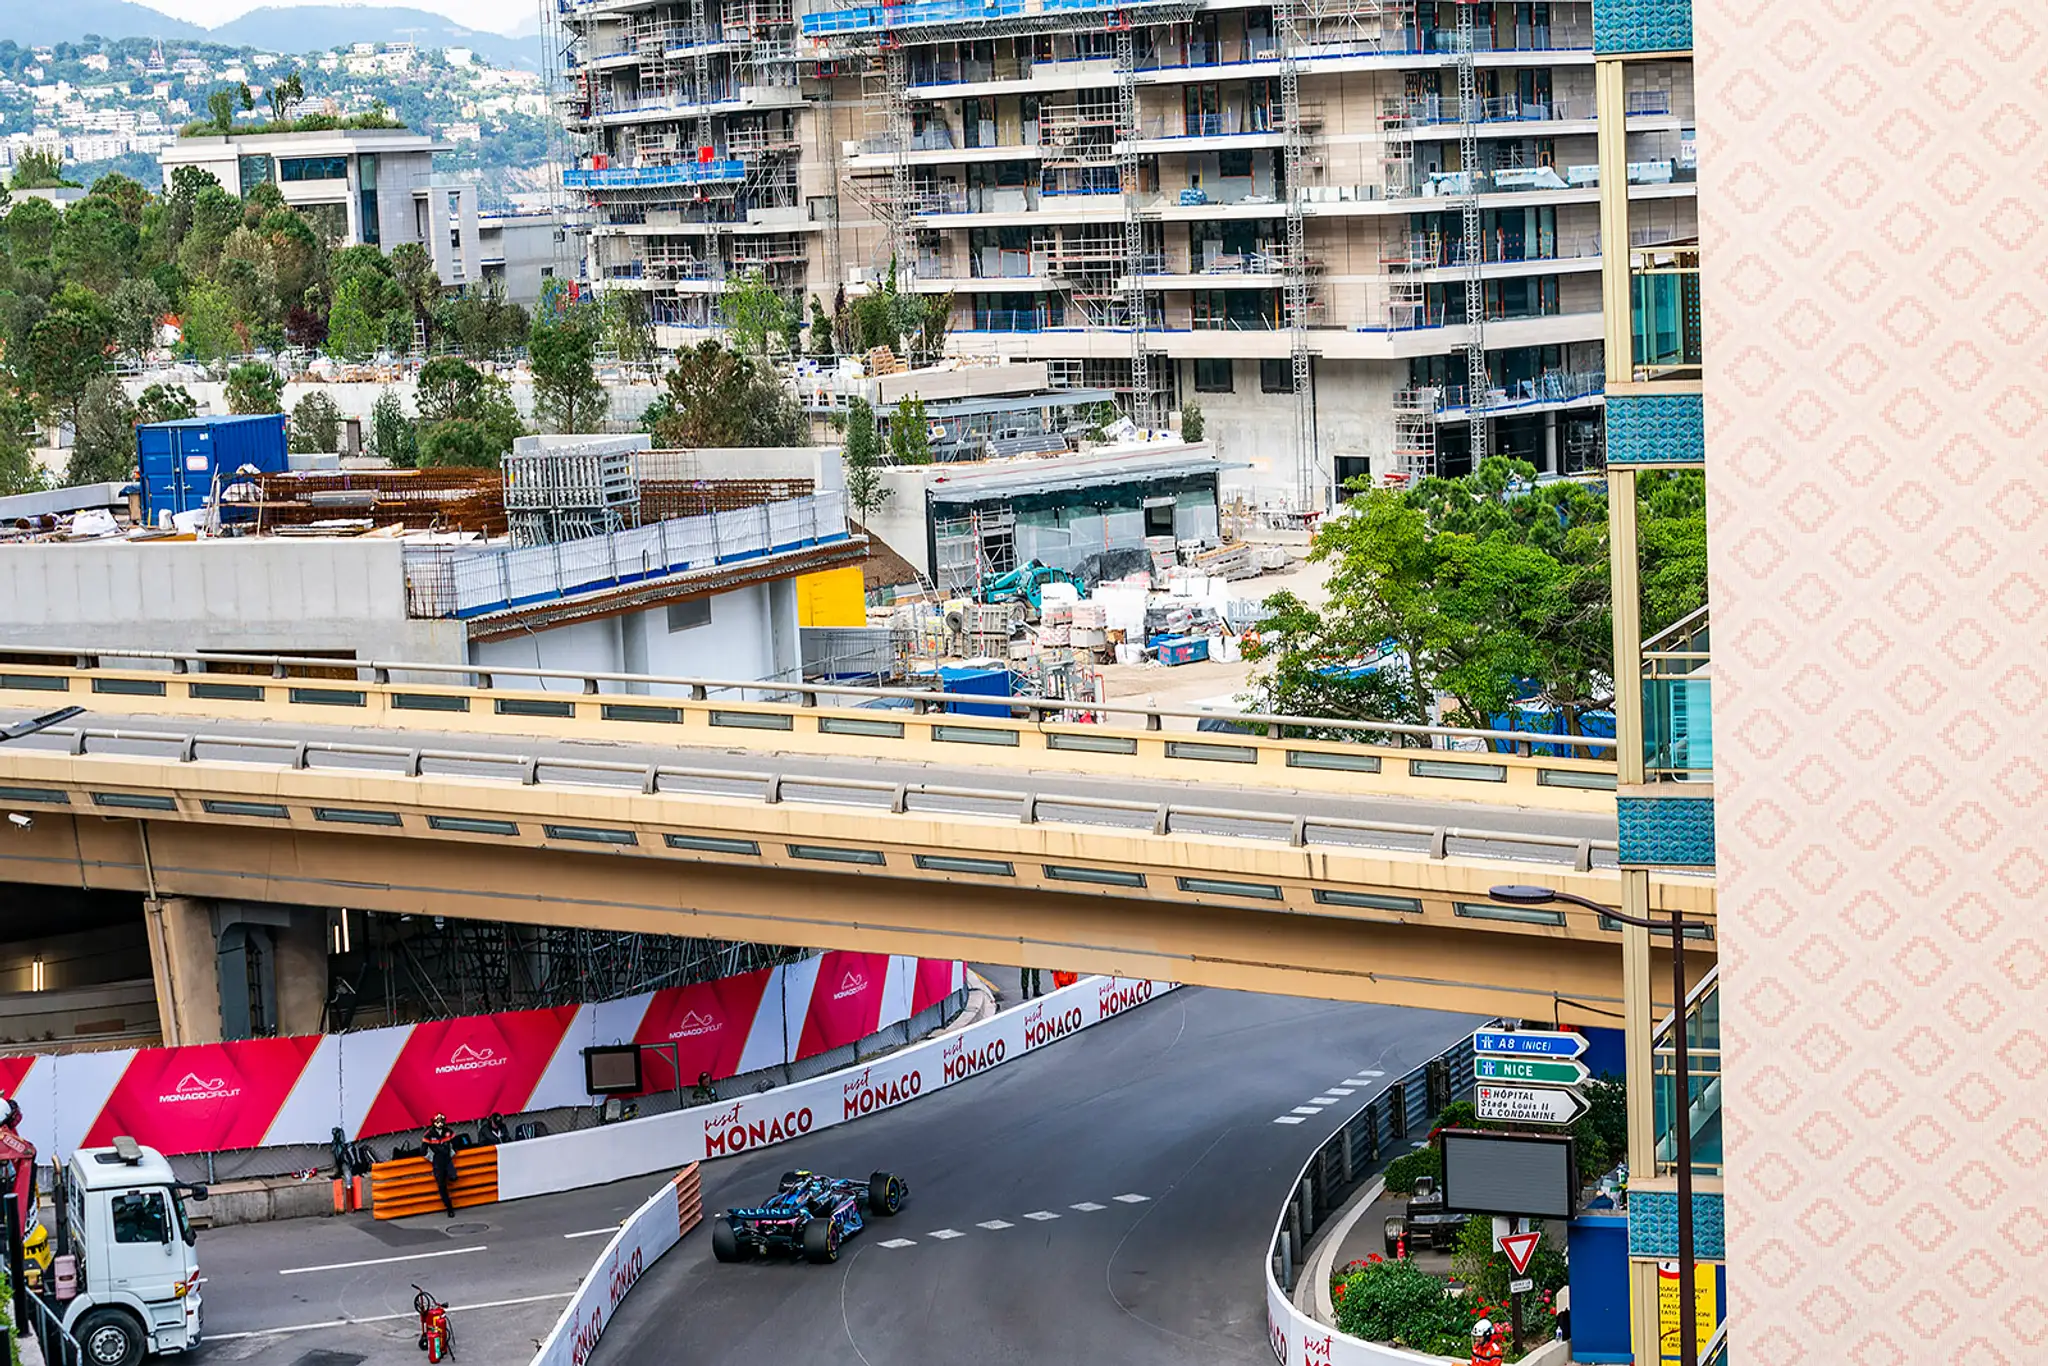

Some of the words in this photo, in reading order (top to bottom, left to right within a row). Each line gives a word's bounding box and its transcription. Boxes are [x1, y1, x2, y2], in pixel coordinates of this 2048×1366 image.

[1100, 980, 1152, 1018] MONACO
[1025, 1007, 1082, 1050] MONACO
[1498, 1038, 1515, 1049] A8
[1522, 1039, 1551, 1051] (NICE)
[943, 1038, 1005, 1084] MONACO
[1504, 1064, 1533, 1076] NICE
[844, 1066, 872, 1095] visit
[844, 1070, 921, 1120] MONACO
[1480, 1099, 1508, 1109] Stade
[1512, 1101, 1537, 1111] Louis
[1493, 1089, 1534, 1100] HÔPITAL
[704, 1102, 744, 1132] visit
[1497, 1110, 1556, 1120] CONDAMINE
[704, 1107, 813, 1158] MONACO
[738, 1208, 792, 1216] ALPINE
[1303, 1335, 1333, 1360] visit
